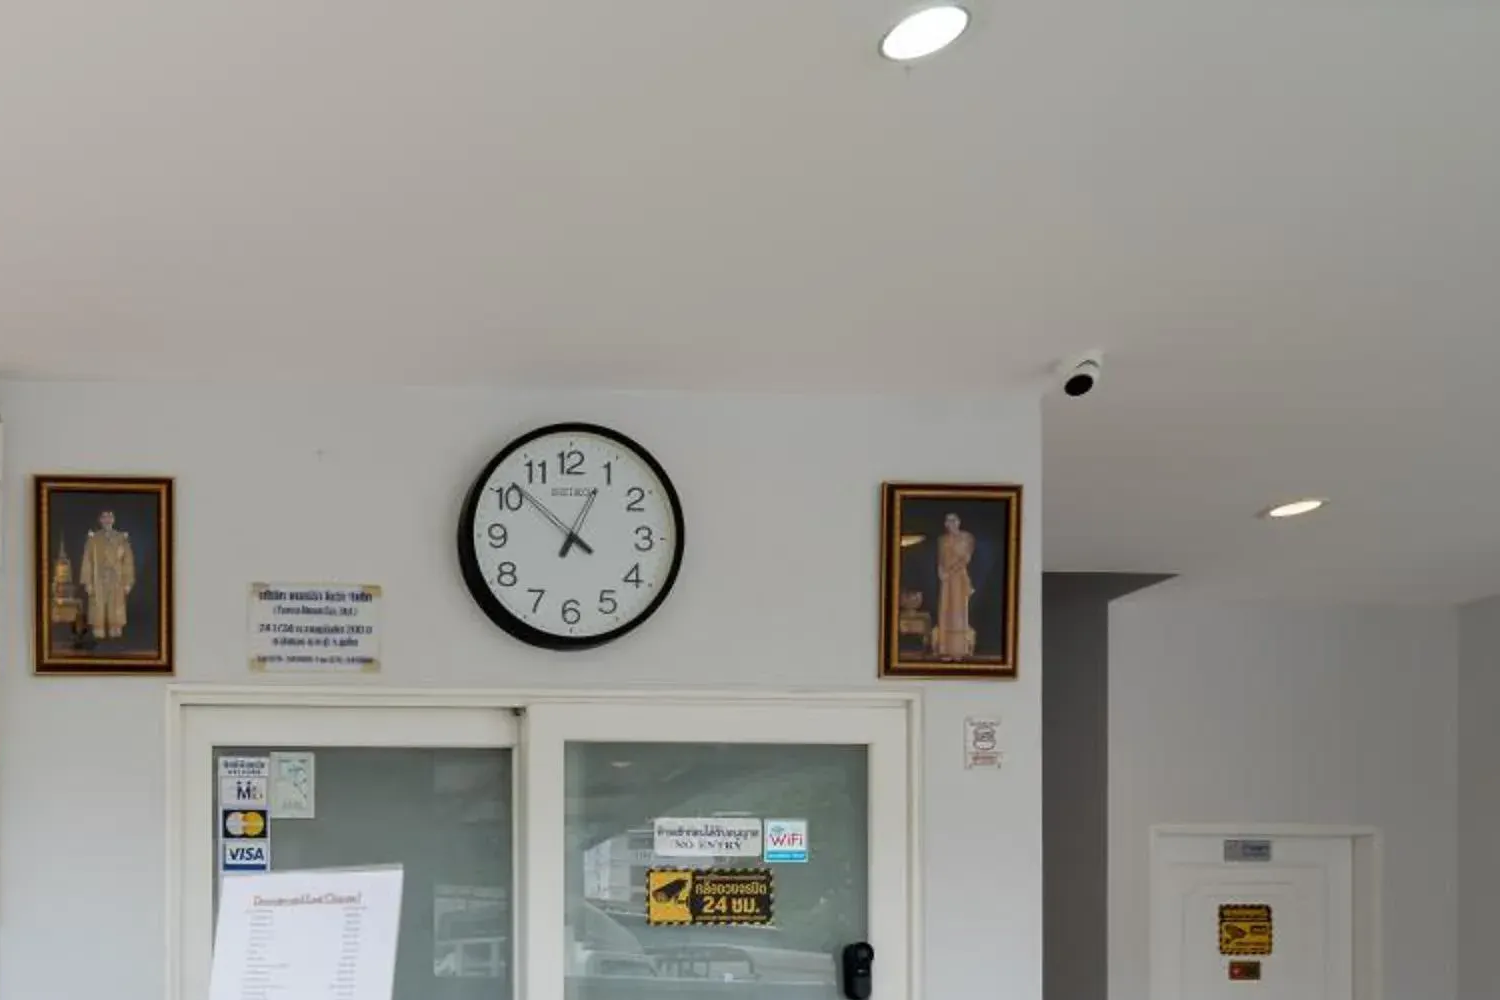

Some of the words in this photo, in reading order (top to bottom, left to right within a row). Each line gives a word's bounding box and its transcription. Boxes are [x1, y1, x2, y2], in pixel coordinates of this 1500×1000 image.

[524, 460, 547, 484] 11
[557, 450, 586, 475] 12
[603, 461, 612, 485] 1
[497, 486, 523, 511] 10
[626, 487, 645, 512] 2
[487, 523, 507, 548] 9
[634, 526, 653, 552] 3
[497, 561, 518, 587] 8
[622, 563, 644, 588] 4
[527, 589, 546, 613] 7
[561, 599, 581, 624] 6
[598, 590, 618, 614] 5
[769, 832, 803, 846] WiFi
[229, 847, 265, 861] VISA
[695, 880, 767, 896] กล้องวงจรปิด
[702, 896, 727, 913] 24
